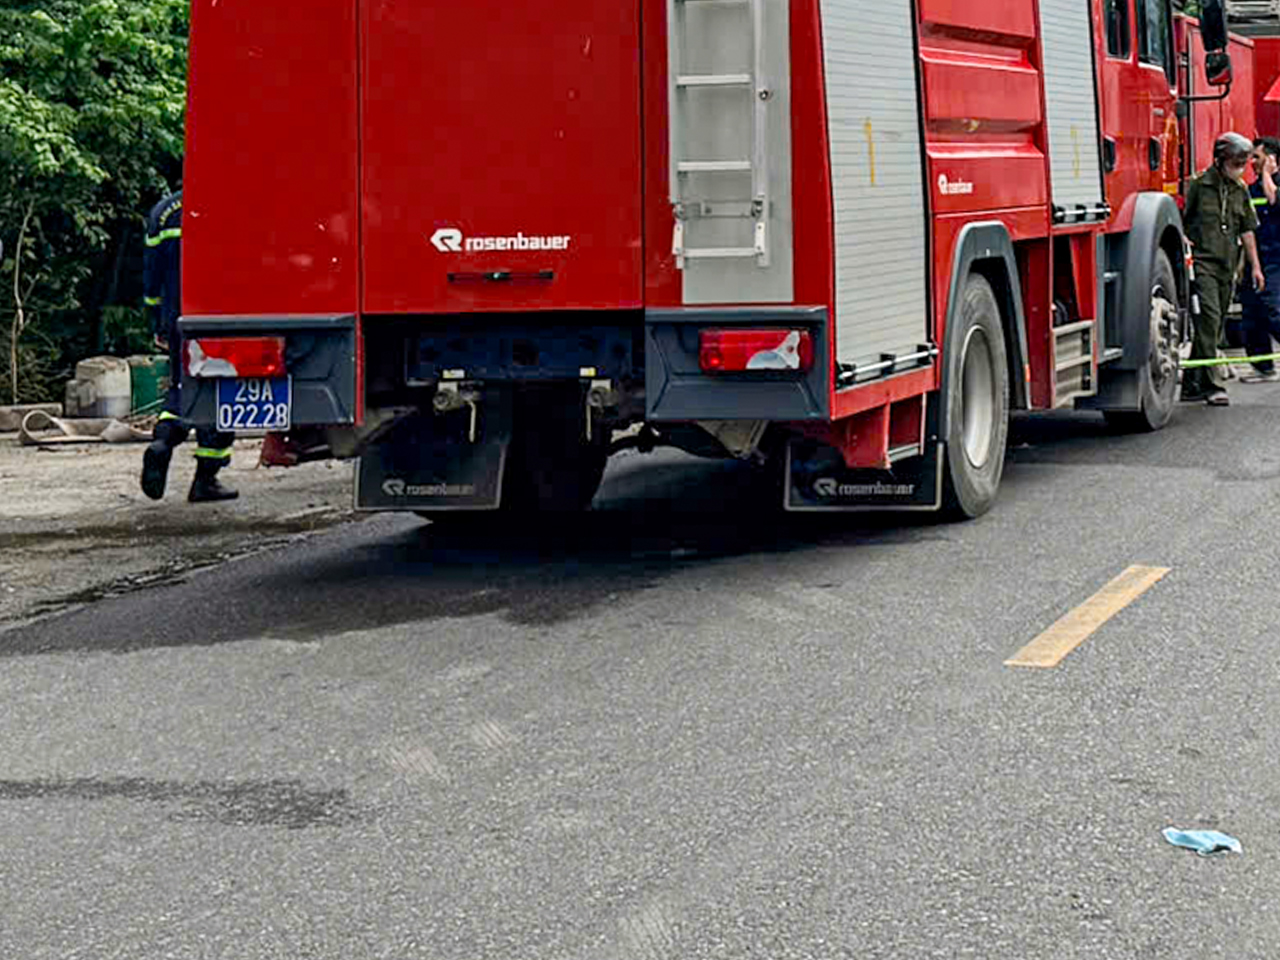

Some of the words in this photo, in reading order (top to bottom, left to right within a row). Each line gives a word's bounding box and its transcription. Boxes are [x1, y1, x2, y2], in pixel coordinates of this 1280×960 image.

[465, 231, 571, 251] rosenbauer
[234, 378, 273, 402] 29A
[219, 403, 288, 428] 022.28
